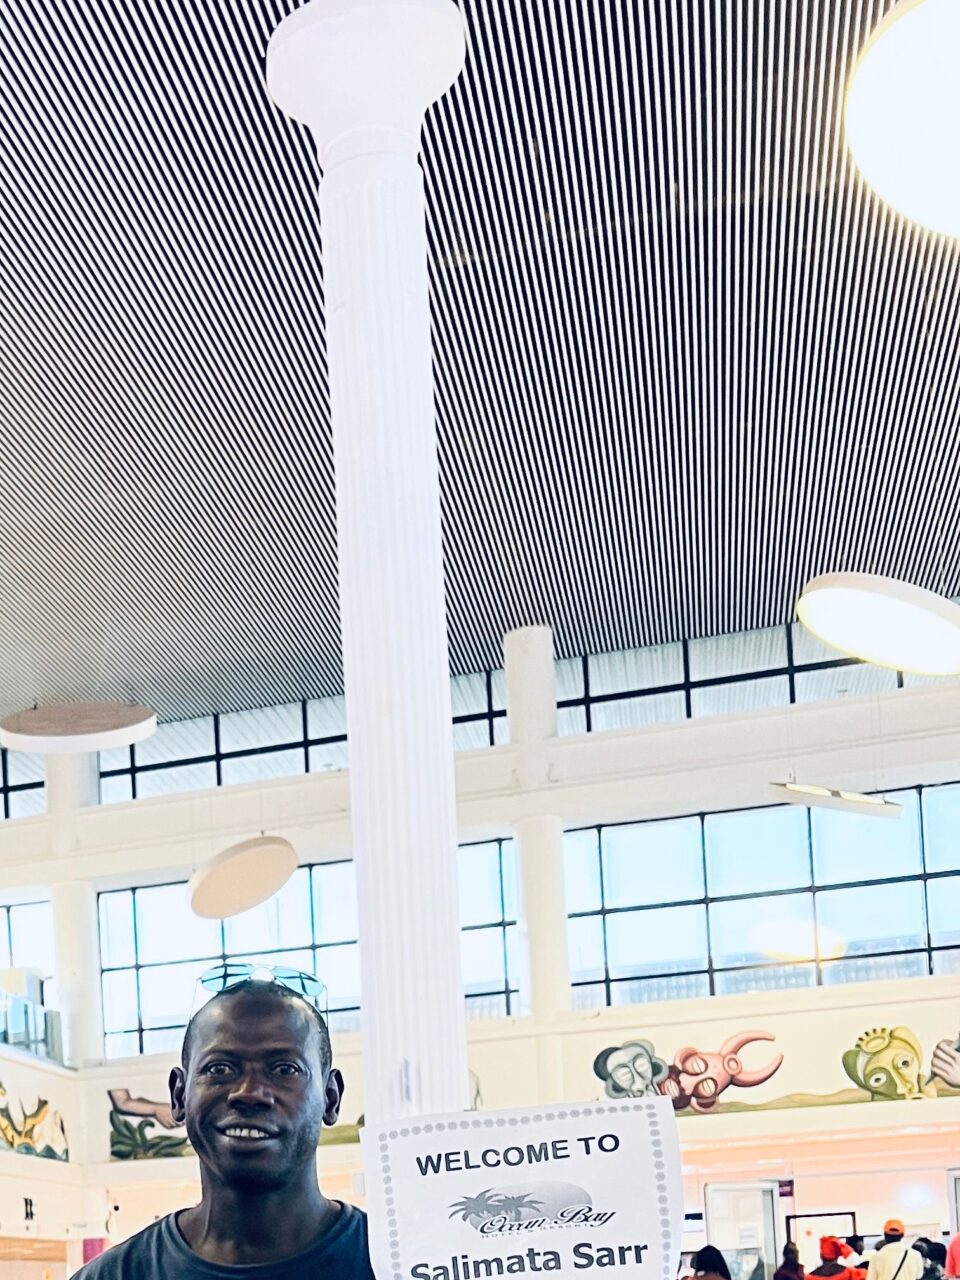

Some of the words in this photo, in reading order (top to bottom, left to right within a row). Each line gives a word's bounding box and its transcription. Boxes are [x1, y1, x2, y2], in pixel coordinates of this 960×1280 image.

[416, 1139, 570, 1176] WELCOME
[577, 1134, 620, 1156] TO
[553, 1205, 617, 1227] Bay
[573, 1242, 648, 1269] Sarr
